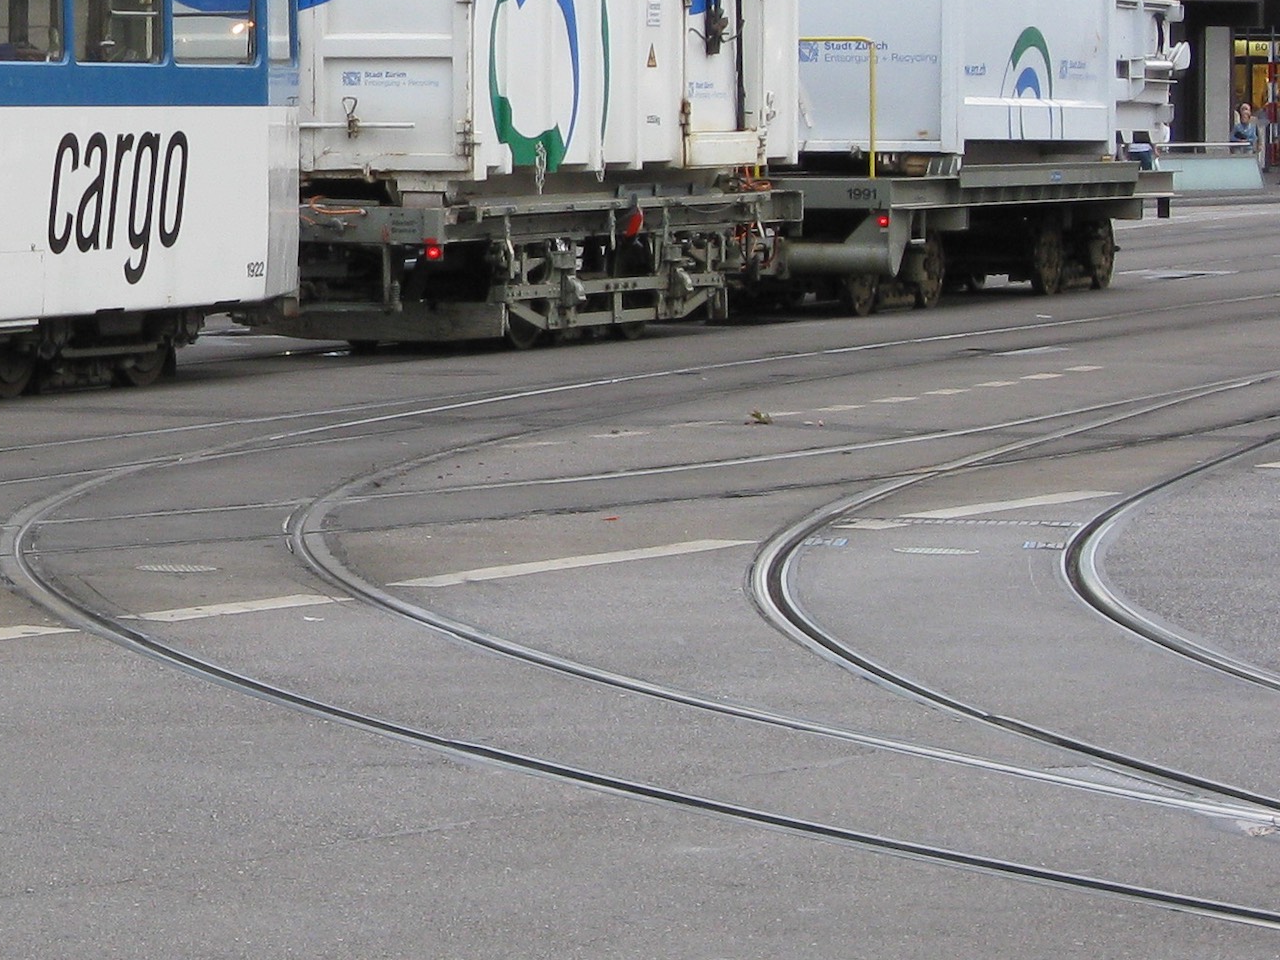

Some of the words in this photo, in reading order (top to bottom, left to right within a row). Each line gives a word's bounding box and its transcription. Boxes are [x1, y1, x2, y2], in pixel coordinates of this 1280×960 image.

[824, 41, 852, 50] Stadt
[891, 53, 937, 63] Recycling
[848, 188, 877, 200] 1991
[48, 131, 188, 284] cargo
[247, 261, 264, 278] 1922
